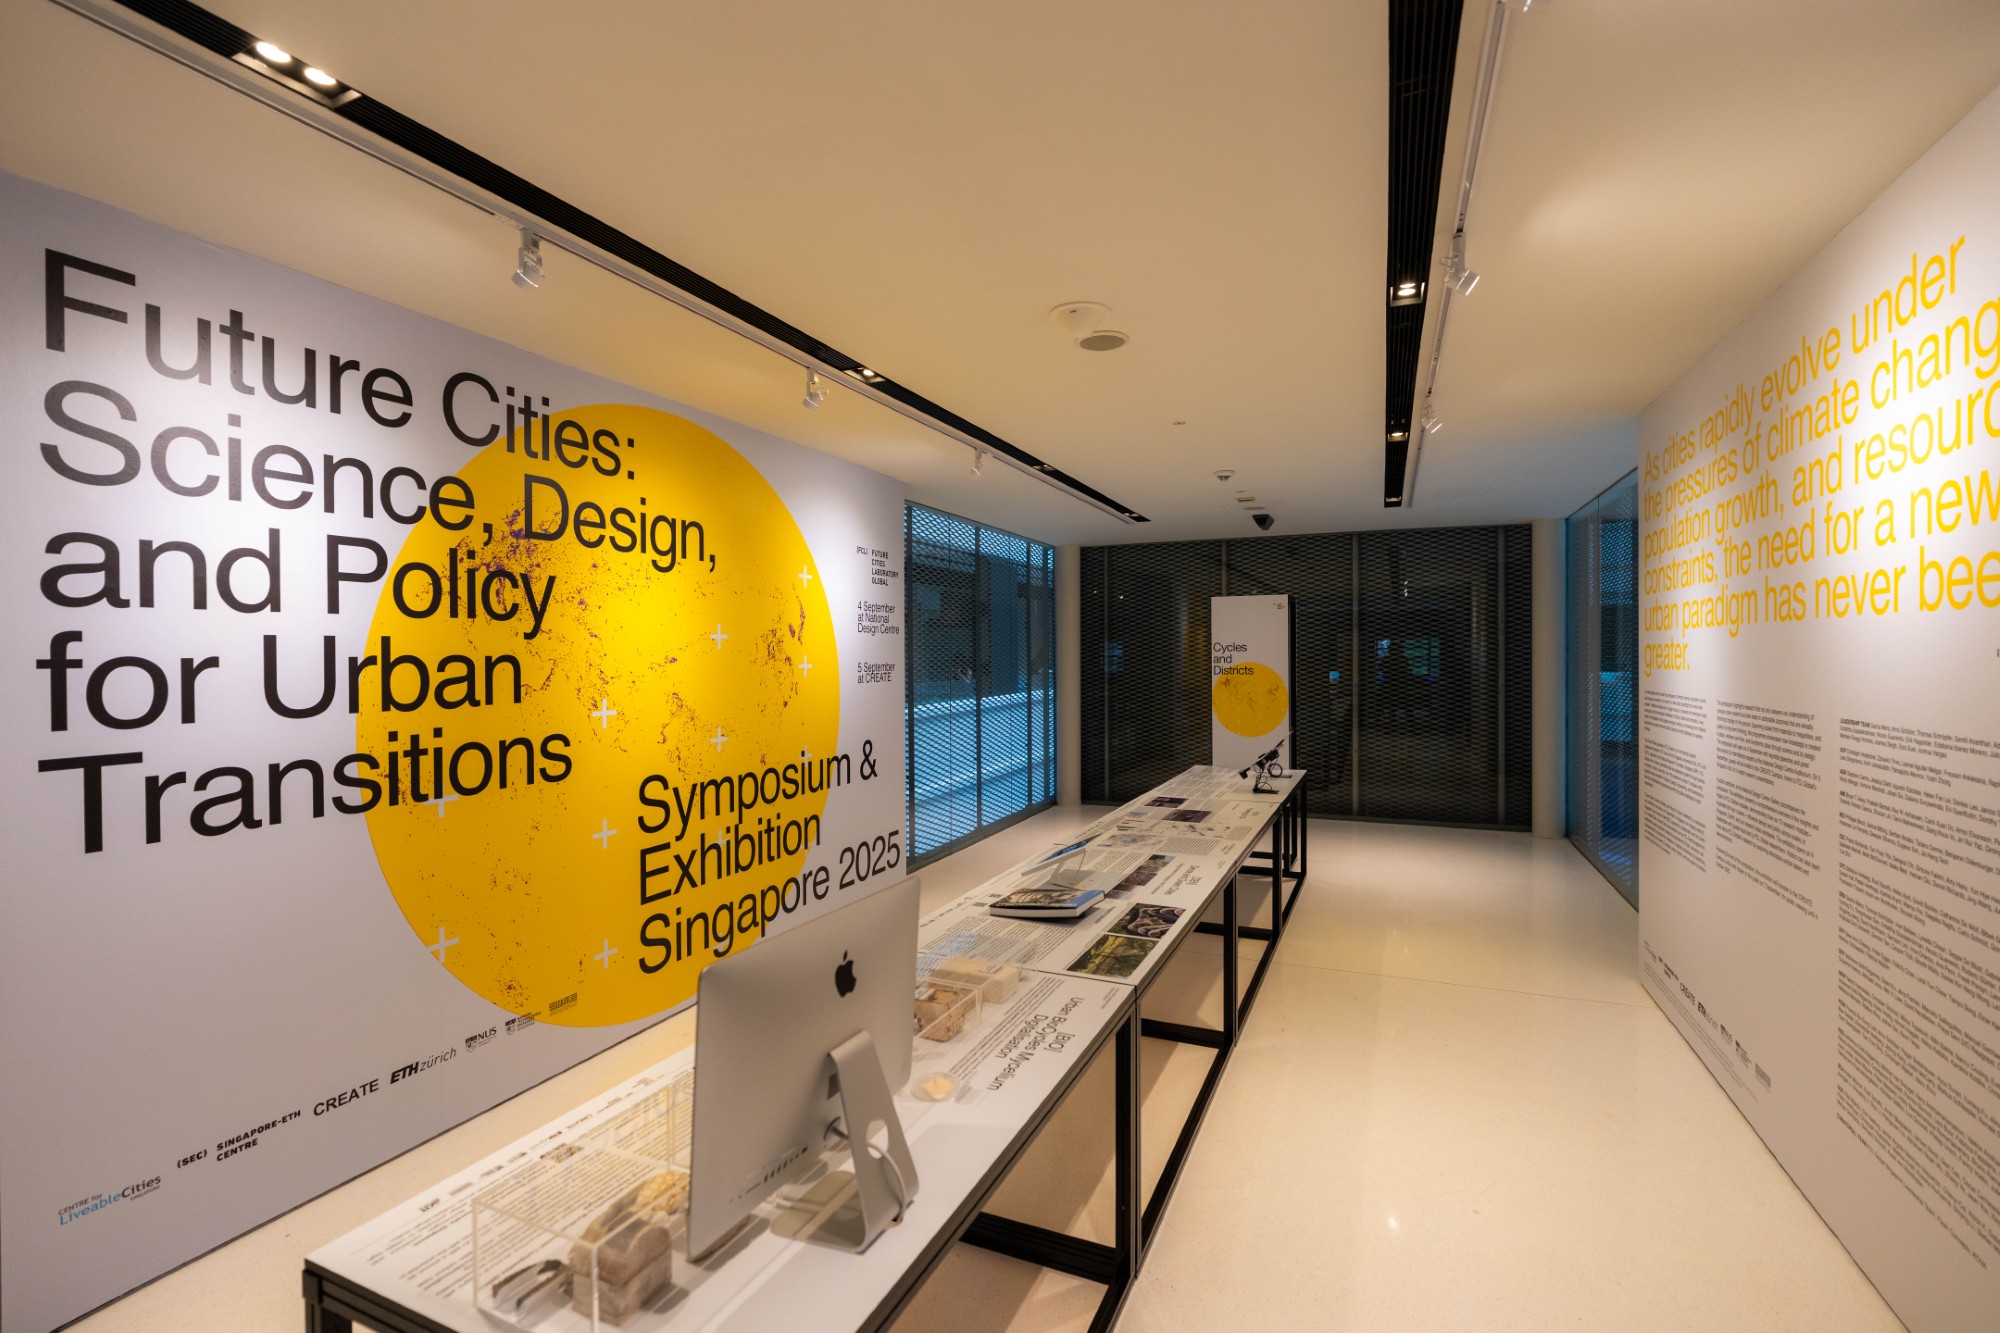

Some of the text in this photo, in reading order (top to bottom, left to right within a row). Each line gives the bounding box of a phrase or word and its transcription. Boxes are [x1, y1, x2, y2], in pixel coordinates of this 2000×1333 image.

[44, 248, 636, 480] Future Cities:
[1644, 235, 1965, 486] As cities rapidly evolve under
[1644, 487, 1662, 522] the
[1666, 447, 1738, 519] pressures
[1743, 420, 1761, 474] of
[1767, 378, 1859, 462] climate
[39, 380, 717, 574] Science, Design,
[1644, 507, 1710, 568] population
[1715, 469, 1784, 546] growth,
[1792, 435, 1842, 507] and
[871, 549, 889, 560] FUTURE
[871, 559, 886, 568] CITIES
[1644, 547, 1718, 596] constraints,
[1724, 535, 1752, 580] the
[1758, 507, 1815, 571] need
[1824, 500, 1864, 556] for
[1875, 498, 1896, 547] a
[39, 528, 556, 640] and Policy
[871, 568, 899, 579] LABORATORY
[871, 577, 889, 586] GLOBAL
[857, 601, 896, 615] 4 September
[857, 612, 890, 624] at National
[1644, 597, 1679, 632] urban
[1682, 584, 1757, 638] paradigm
[1765, 575, 1807, 623] has
[1815, 564, 1906, 619] never
[857, 623, 900, 637] Design Centre
[1213, 642, 1248, 655] Cycles
[857, 662, 896, 676] 5 September
[1213, 654, 1233, 664] and
[1213, 665, 1254, 676] Districts
[1644, 636, 1690, 678] greater.
[36, 630, 522, 732] for Urban
[857, 672, 892, 683] at CREATE
[37, 727, 573, 855] Transitions
[638, 740, 878, 842] Symposium &
[640, 813, 820, 906] Exhibition
[638, 865, 830, 974] Singapore
[839, 830, 900, 890] 2025
[1057, 997, 1085, 1018] Urban
[477, 1026, 497, 1041] NUS
[987, 1051, 1035, 1091] Mycelium
[313, 1078, 379, 1116] CREATE
[177, 1110, 301, 1168] (SEC) SINGAPORE-ETH
[217, 1138, 258, 1161] CENTRE
[58, 1193, 103, 1216] CENTRE for
